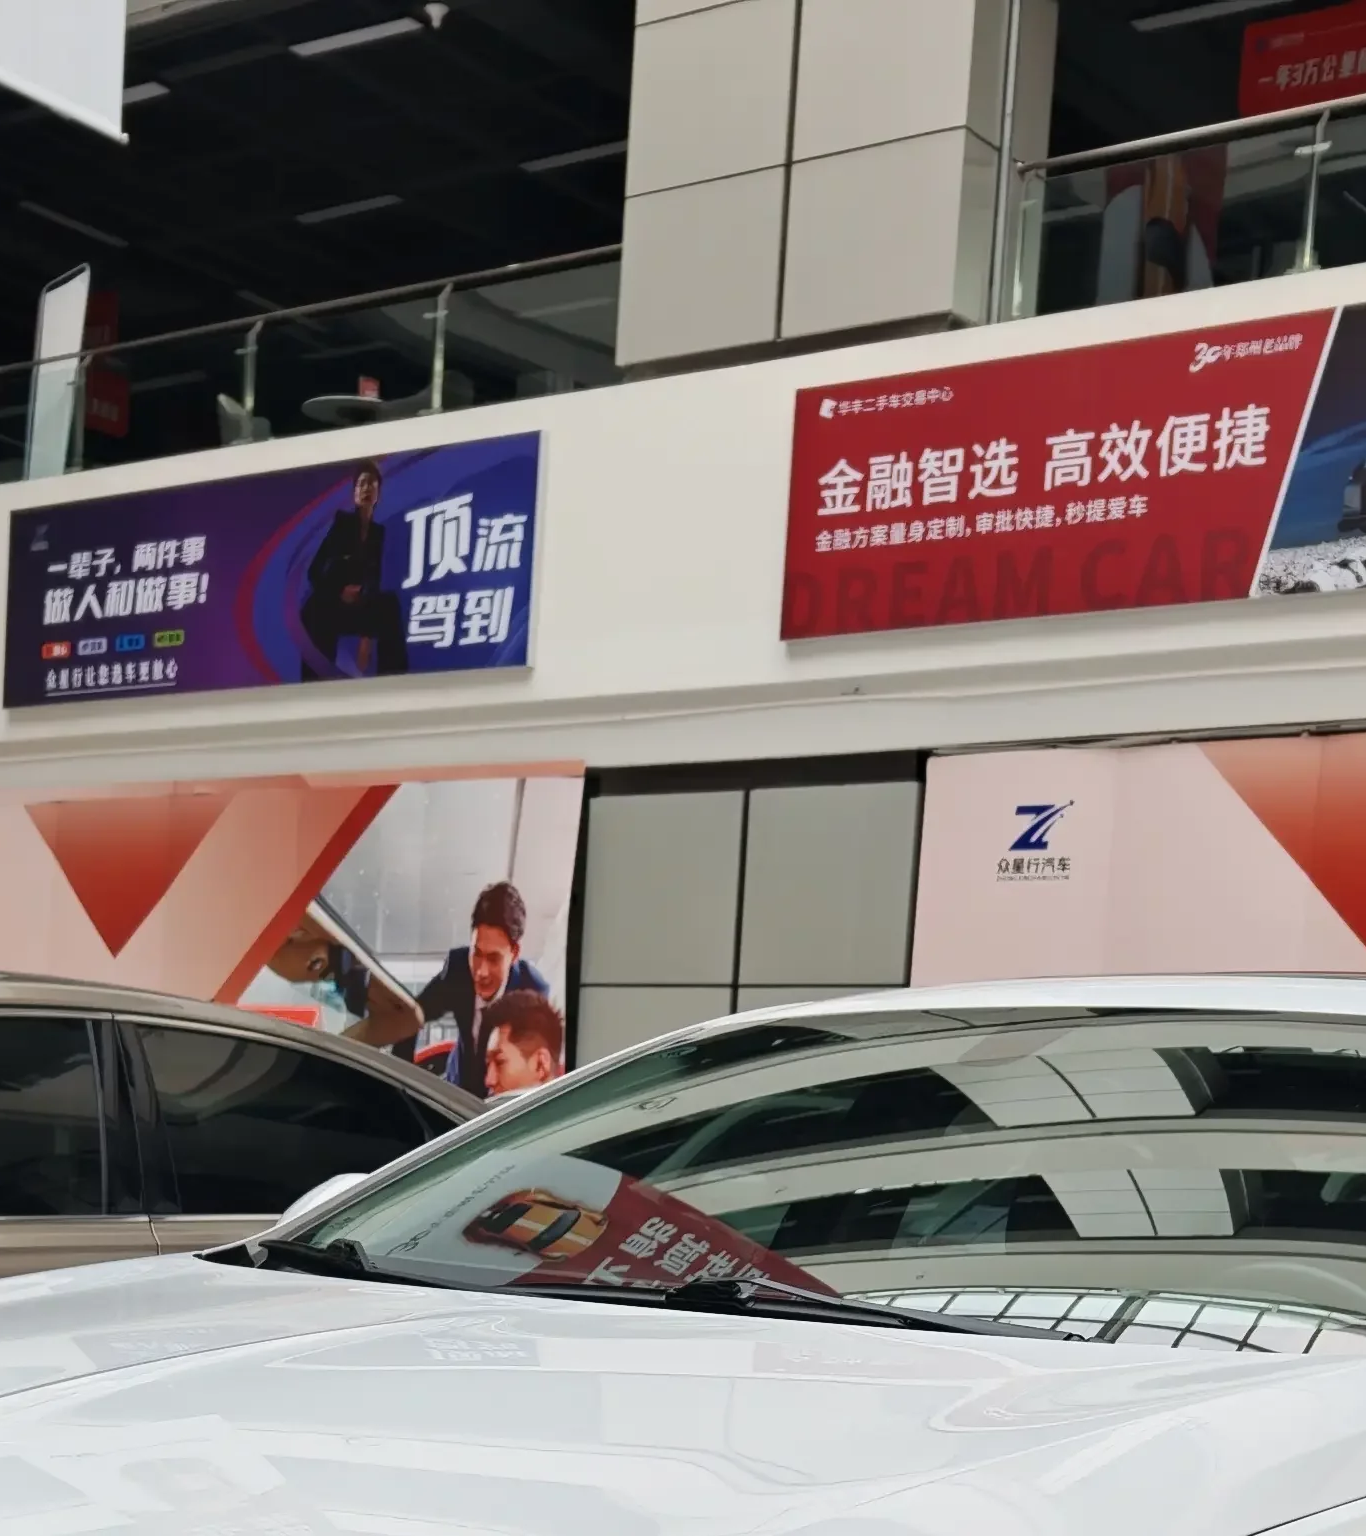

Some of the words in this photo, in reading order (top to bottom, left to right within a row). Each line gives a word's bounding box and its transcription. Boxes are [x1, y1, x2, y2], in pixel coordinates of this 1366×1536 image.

[815, 437, 1019, 516] 金融智选
[1043, 403, 1271, 493] 高效便捷
[401, 491, 529, 590] 顶流
[406, 586, 515, 649] 驾到
[996, 855, 1071, 875] 众星行汽车
